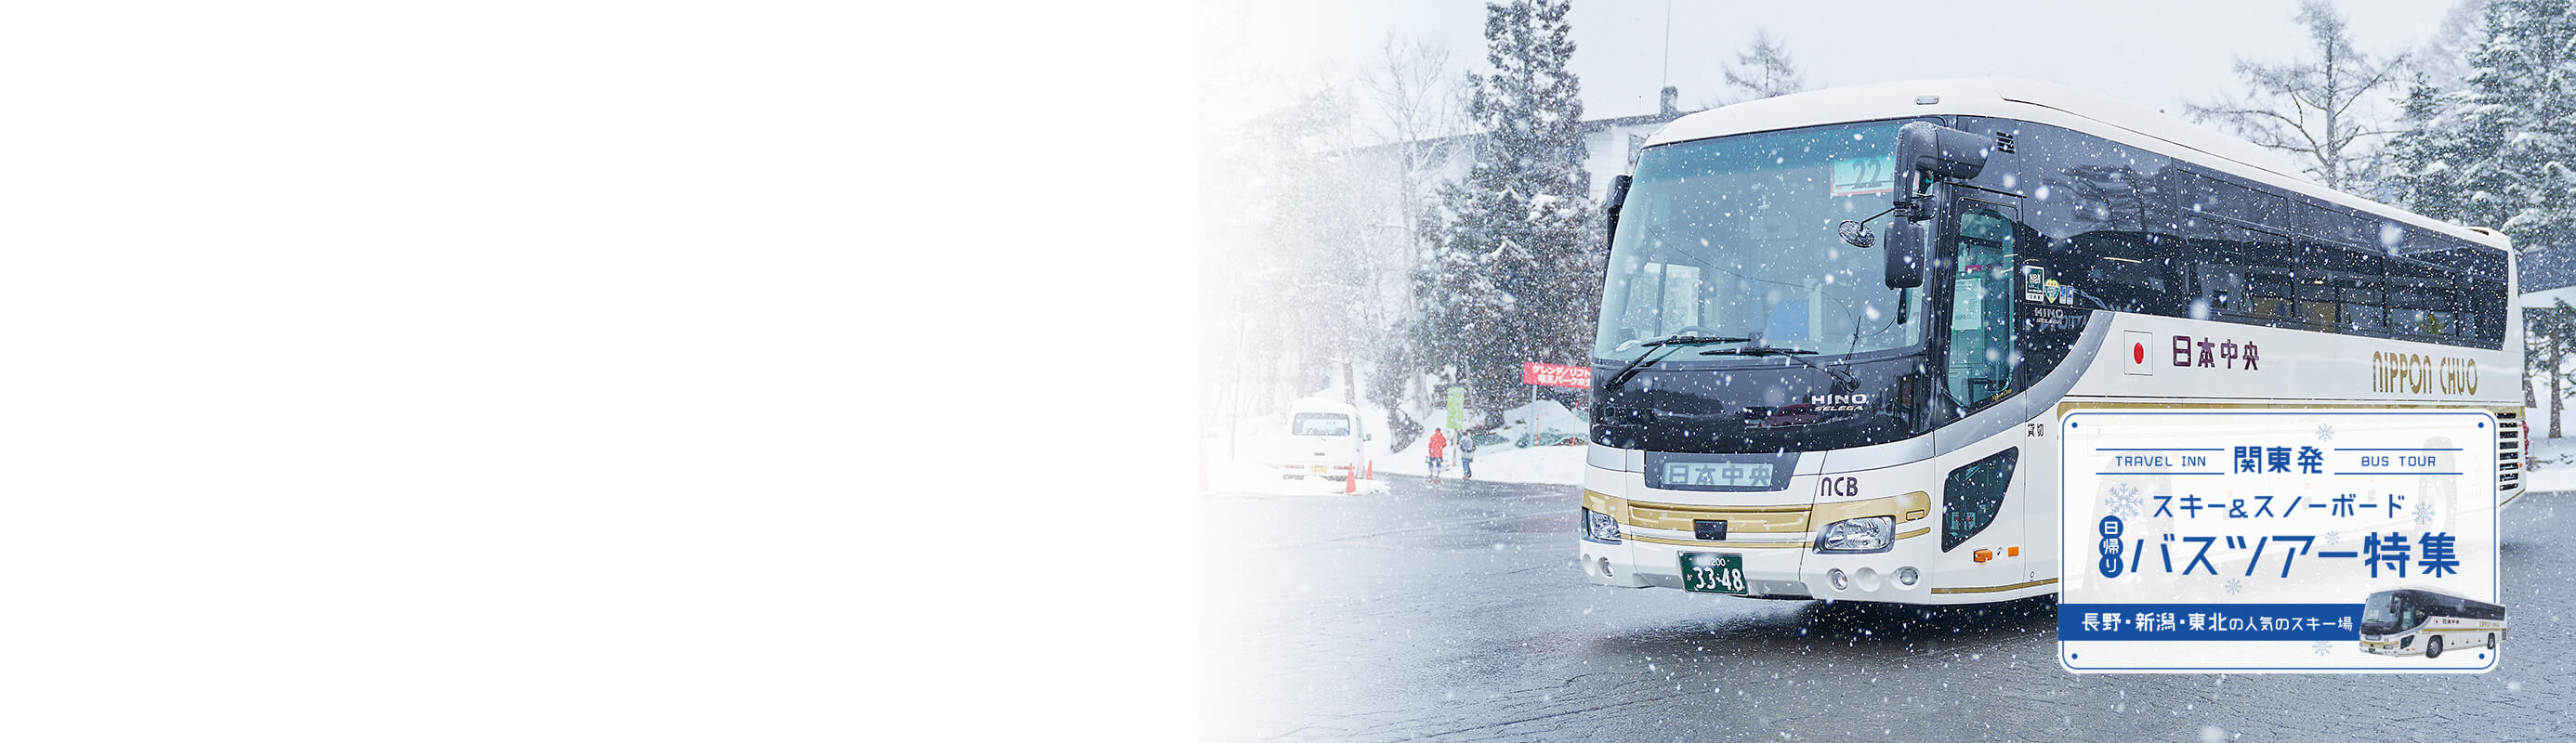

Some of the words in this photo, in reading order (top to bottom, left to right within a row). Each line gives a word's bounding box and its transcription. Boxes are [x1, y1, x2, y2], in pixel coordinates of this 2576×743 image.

[1852, 159, 1882, 189] 22
[2034, 307, 2064, 319] HINO
[2173, 335, 2260, 371] 日本中央
[2372, 350, 2433, 395] NIPPON
[2440, 357, 2478, 396] CHUO
[1811, 393, 1867, 406] HINO
[2027, 423, 2044, 437] 貸切
[1670, 464, 1771, 487] 日本中央
[1820, 476, 1859, 497] NCB
[1711, 557, 1726, 567] 200
